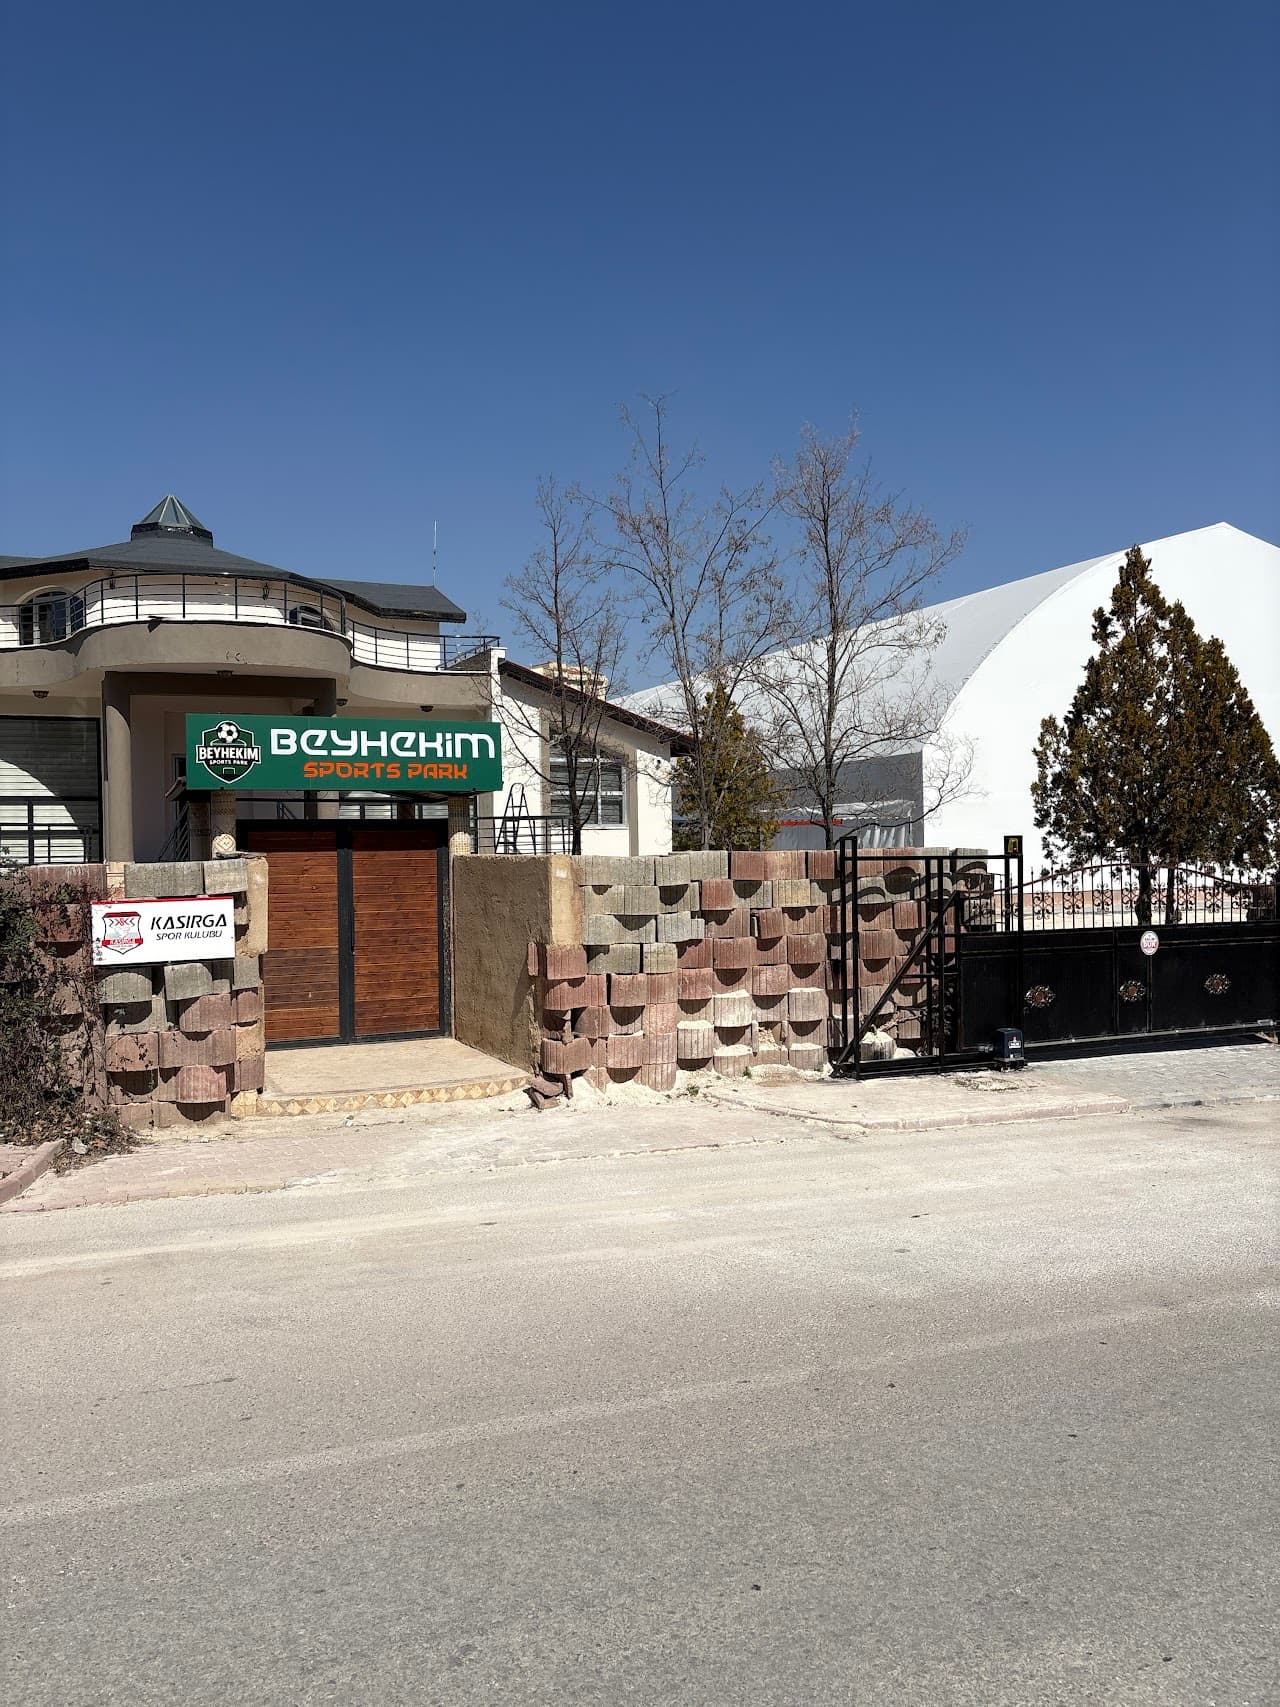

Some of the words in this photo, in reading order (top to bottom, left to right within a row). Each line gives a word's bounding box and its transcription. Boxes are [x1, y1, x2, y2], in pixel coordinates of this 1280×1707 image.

[303, 761, 401, 779] SPORTS
[407, 763, 467, 780] PARK
[150, 913, 227, 930] KASIRGA
[156, 932, 182, 941] SPOR
